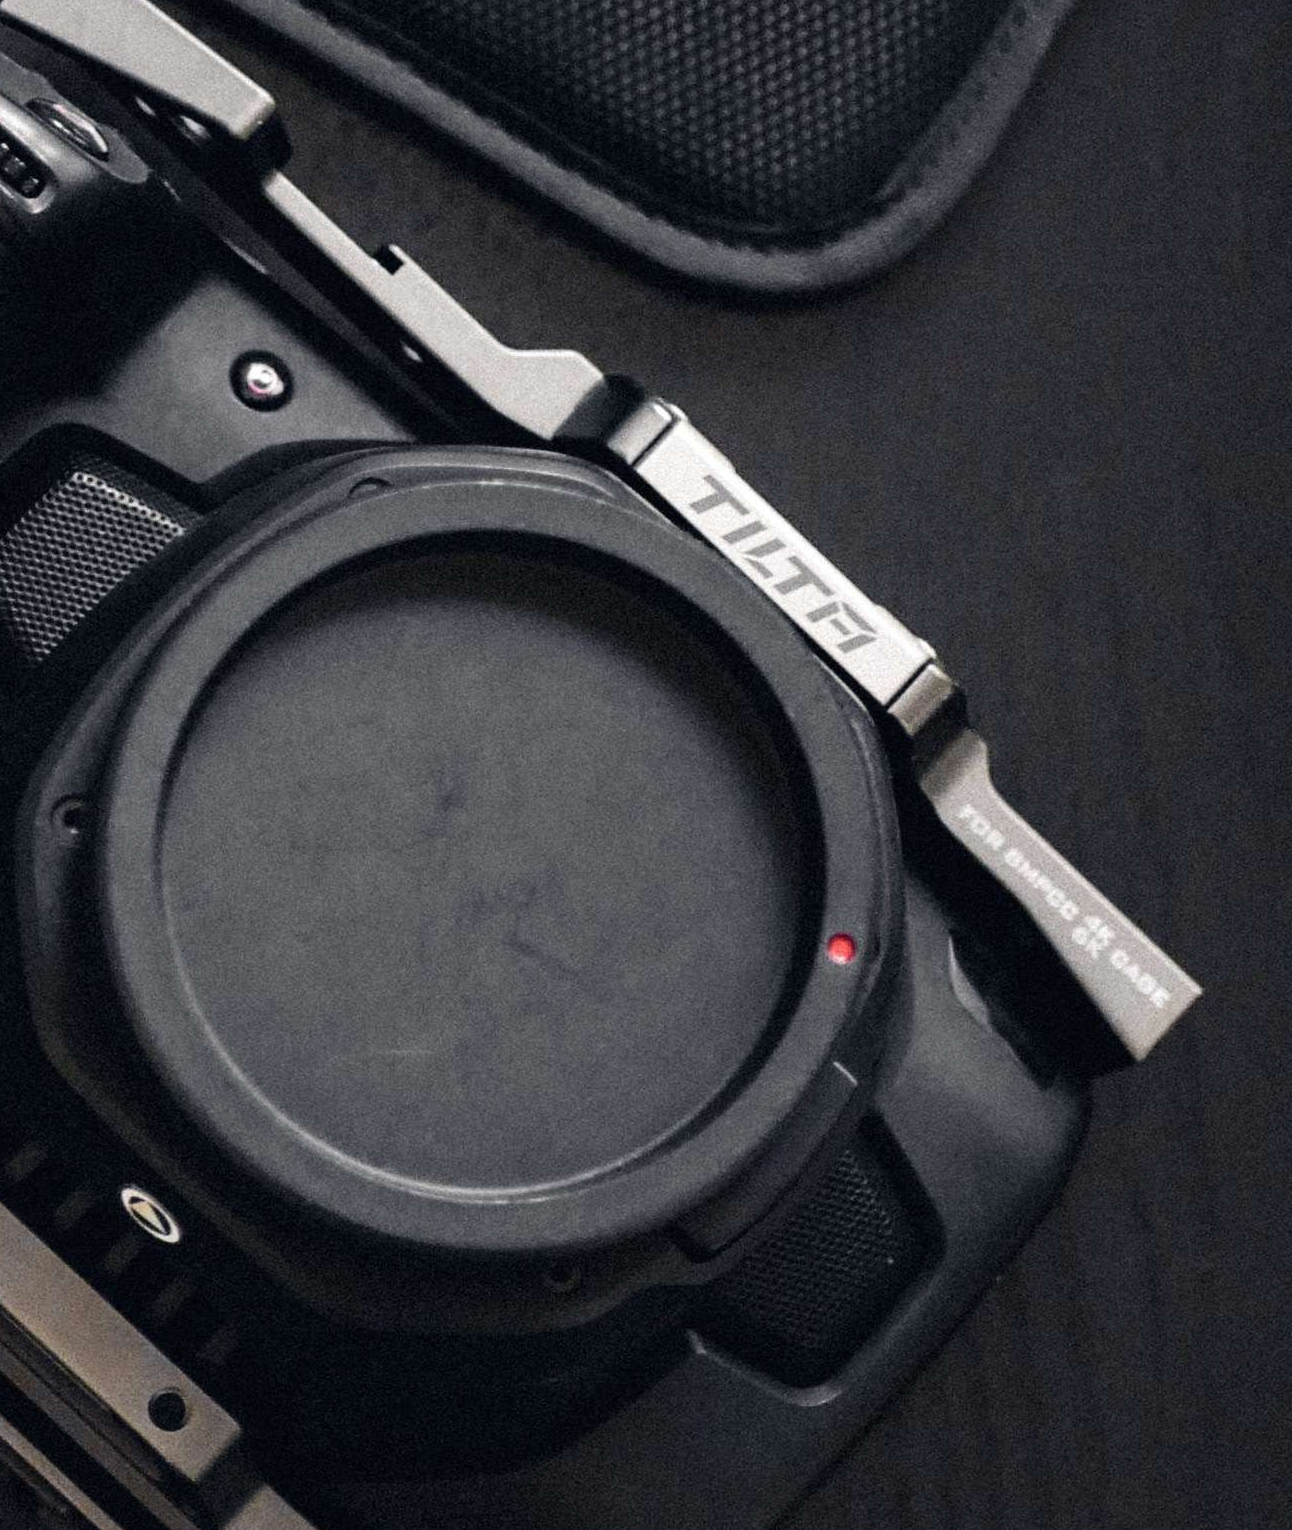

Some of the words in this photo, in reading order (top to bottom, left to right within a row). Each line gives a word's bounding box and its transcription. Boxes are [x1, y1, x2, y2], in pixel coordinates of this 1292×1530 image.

[688, 474, 878, 655] TILTA
[959, 804, 1004, 849] FOR
[1109, 951, 1172, 1009] CASE
